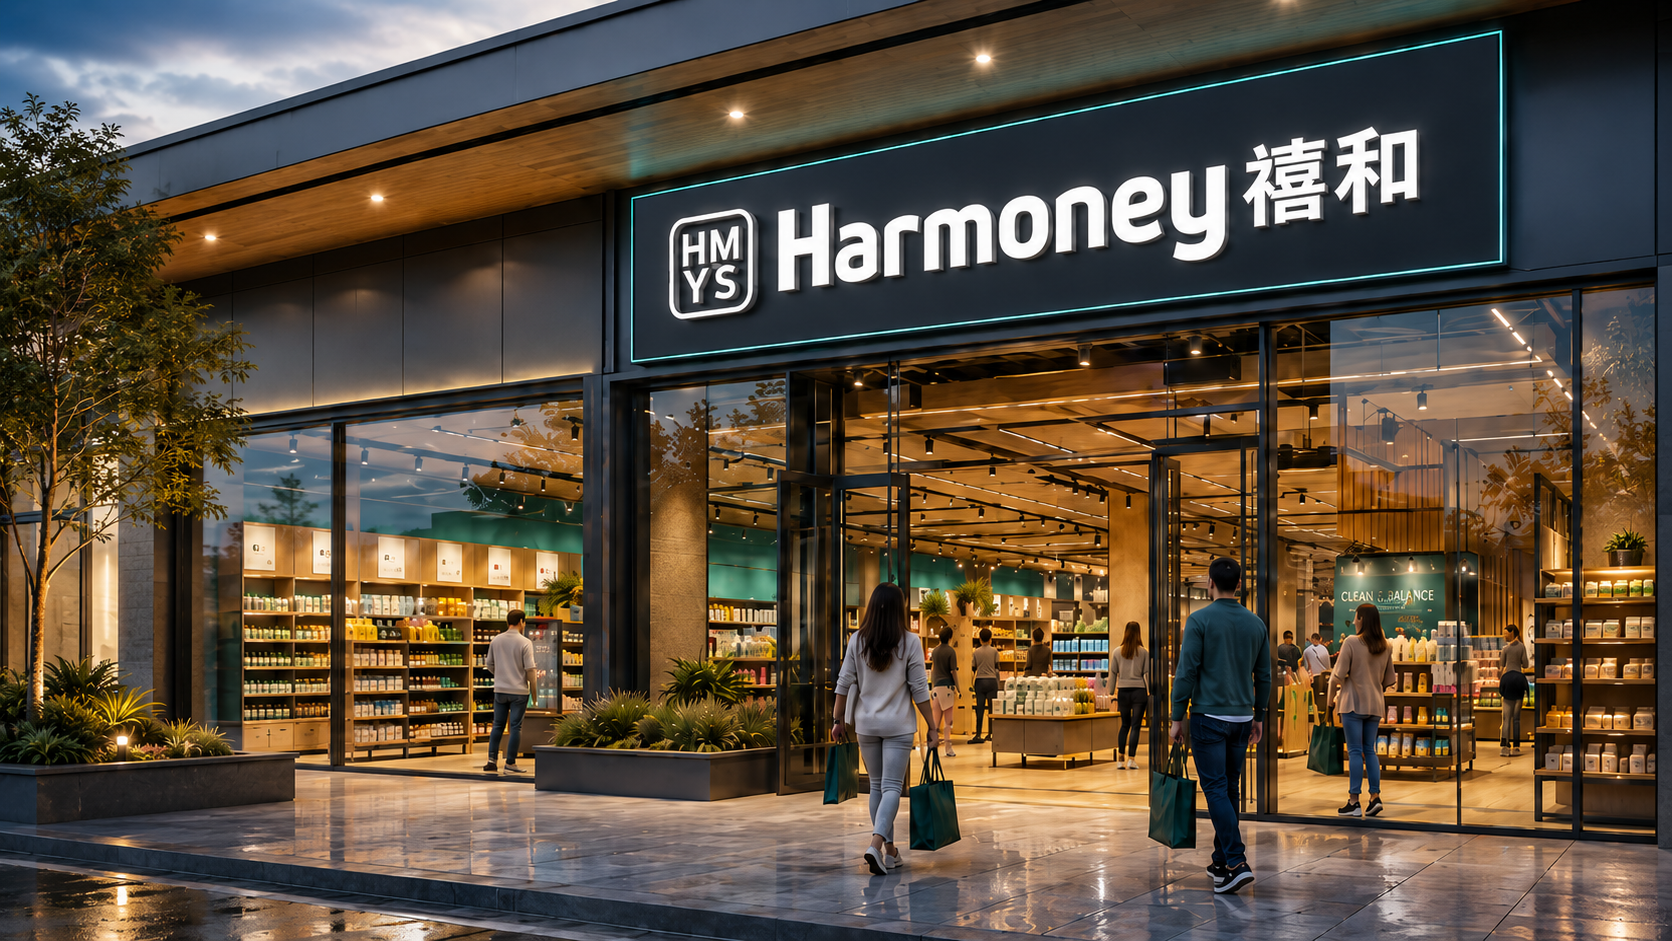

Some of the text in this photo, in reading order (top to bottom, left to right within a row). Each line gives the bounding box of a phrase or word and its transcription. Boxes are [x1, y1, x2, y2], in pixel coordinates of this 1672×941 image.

[777, 127, 1419, 291] Harmoney 禧和
[682, 225, 740, 267] HM
[683, 264, 736, 304] YS
[1341, 591, 1374, 602] CLEAN
[1388, 590, 1434, 601] BALANCE
